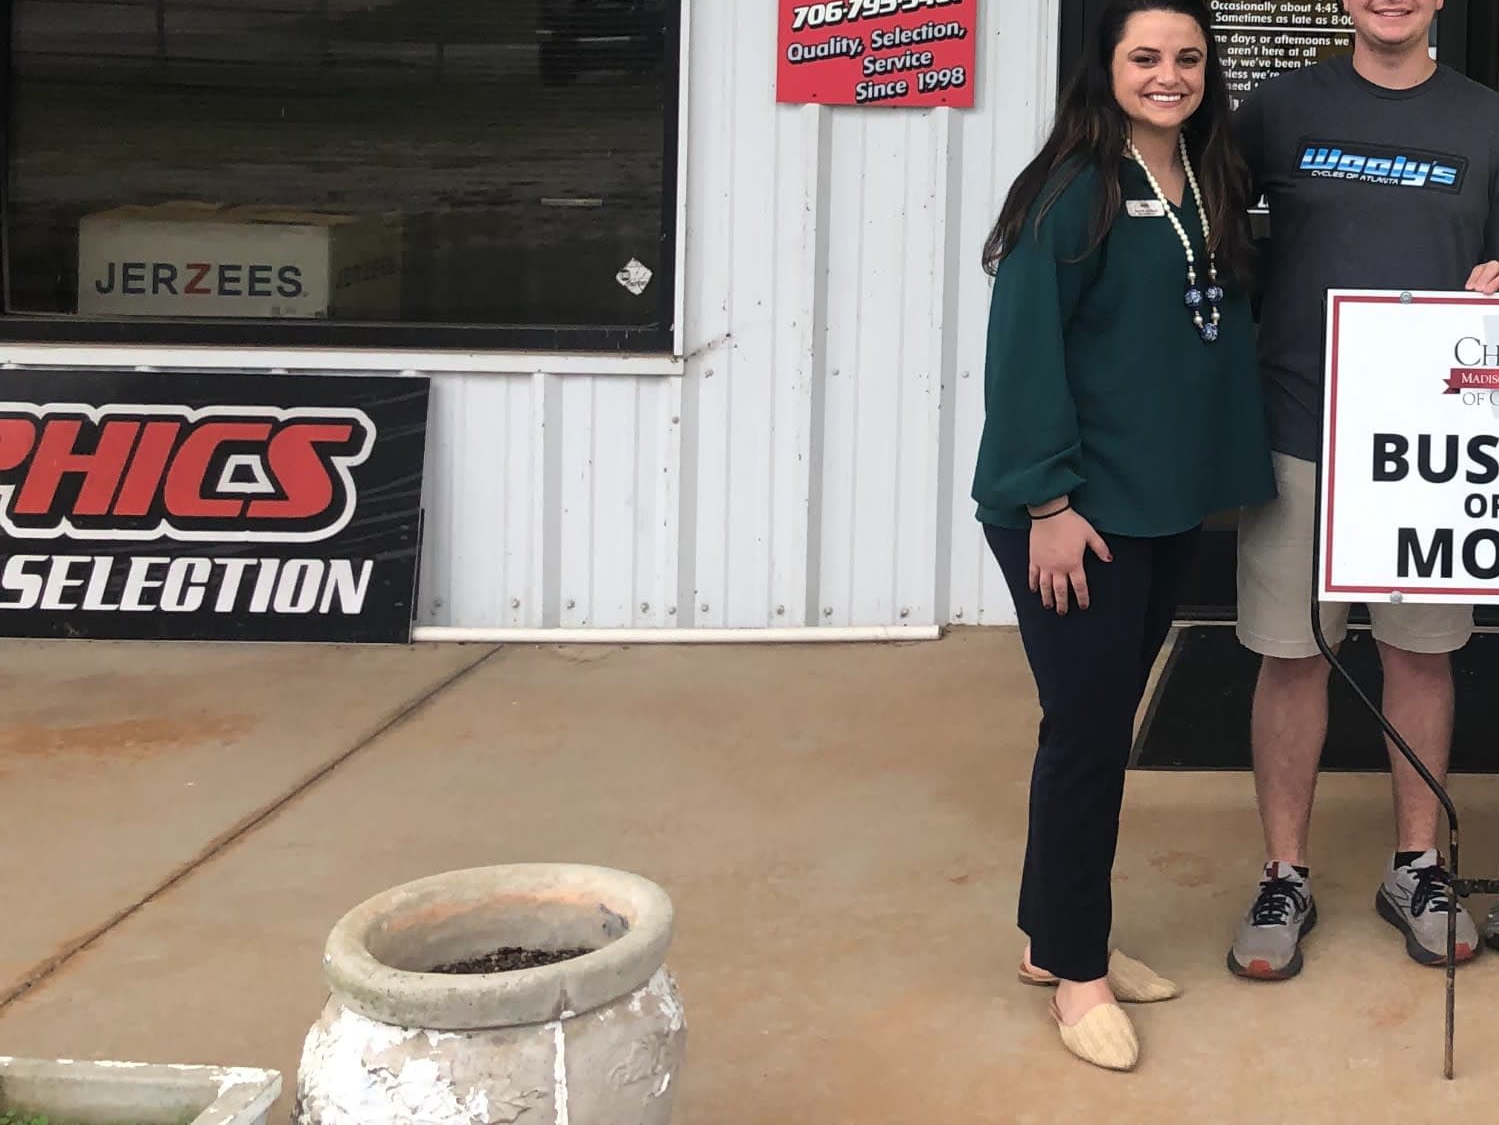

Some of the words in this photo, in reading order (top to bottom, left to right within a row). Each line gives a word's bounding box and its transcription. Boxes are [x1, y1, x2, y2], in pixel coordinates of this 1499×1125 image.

[1210, 0, 1276, 13] Occasionally
[1280, 1, 1311, 12] about
[1314, 3, 1339, 13] 4:45
[1215, 12, 1272, 23] Sometimes
[1275, 15, 1288, 24] as
[1291, 14, 1312, 24] late
[1315, 16, 1328, 25] as
[787, 36, 863, 62] Quality,
[871, 21, 966, 49] Selection,
[1230, 33, 1256, 45] days
[1259, 35, 1272, 44] or
[1274, 34, 1331, 45] afternoons
[1334, 37, 1350, 46] we
[1227, 45, 1258, 55] aren't
[1261, 45, 1285, 56] here
[1288, 47, 1300, 57] at
[1302, 46, 1317, 57] all
[863, 50, 932, 74] Service
[1240, 57, 1271, 68] we've
[1274, 58, 1301, 68] been
[855, 80, 907, 101] Since
[918, 67, 965, 91] 1998
[95, 262, 302, 298] JERZEES
[1462, 391, 1486, 406] OF
[0, 555, 373, 615] SELECTION
